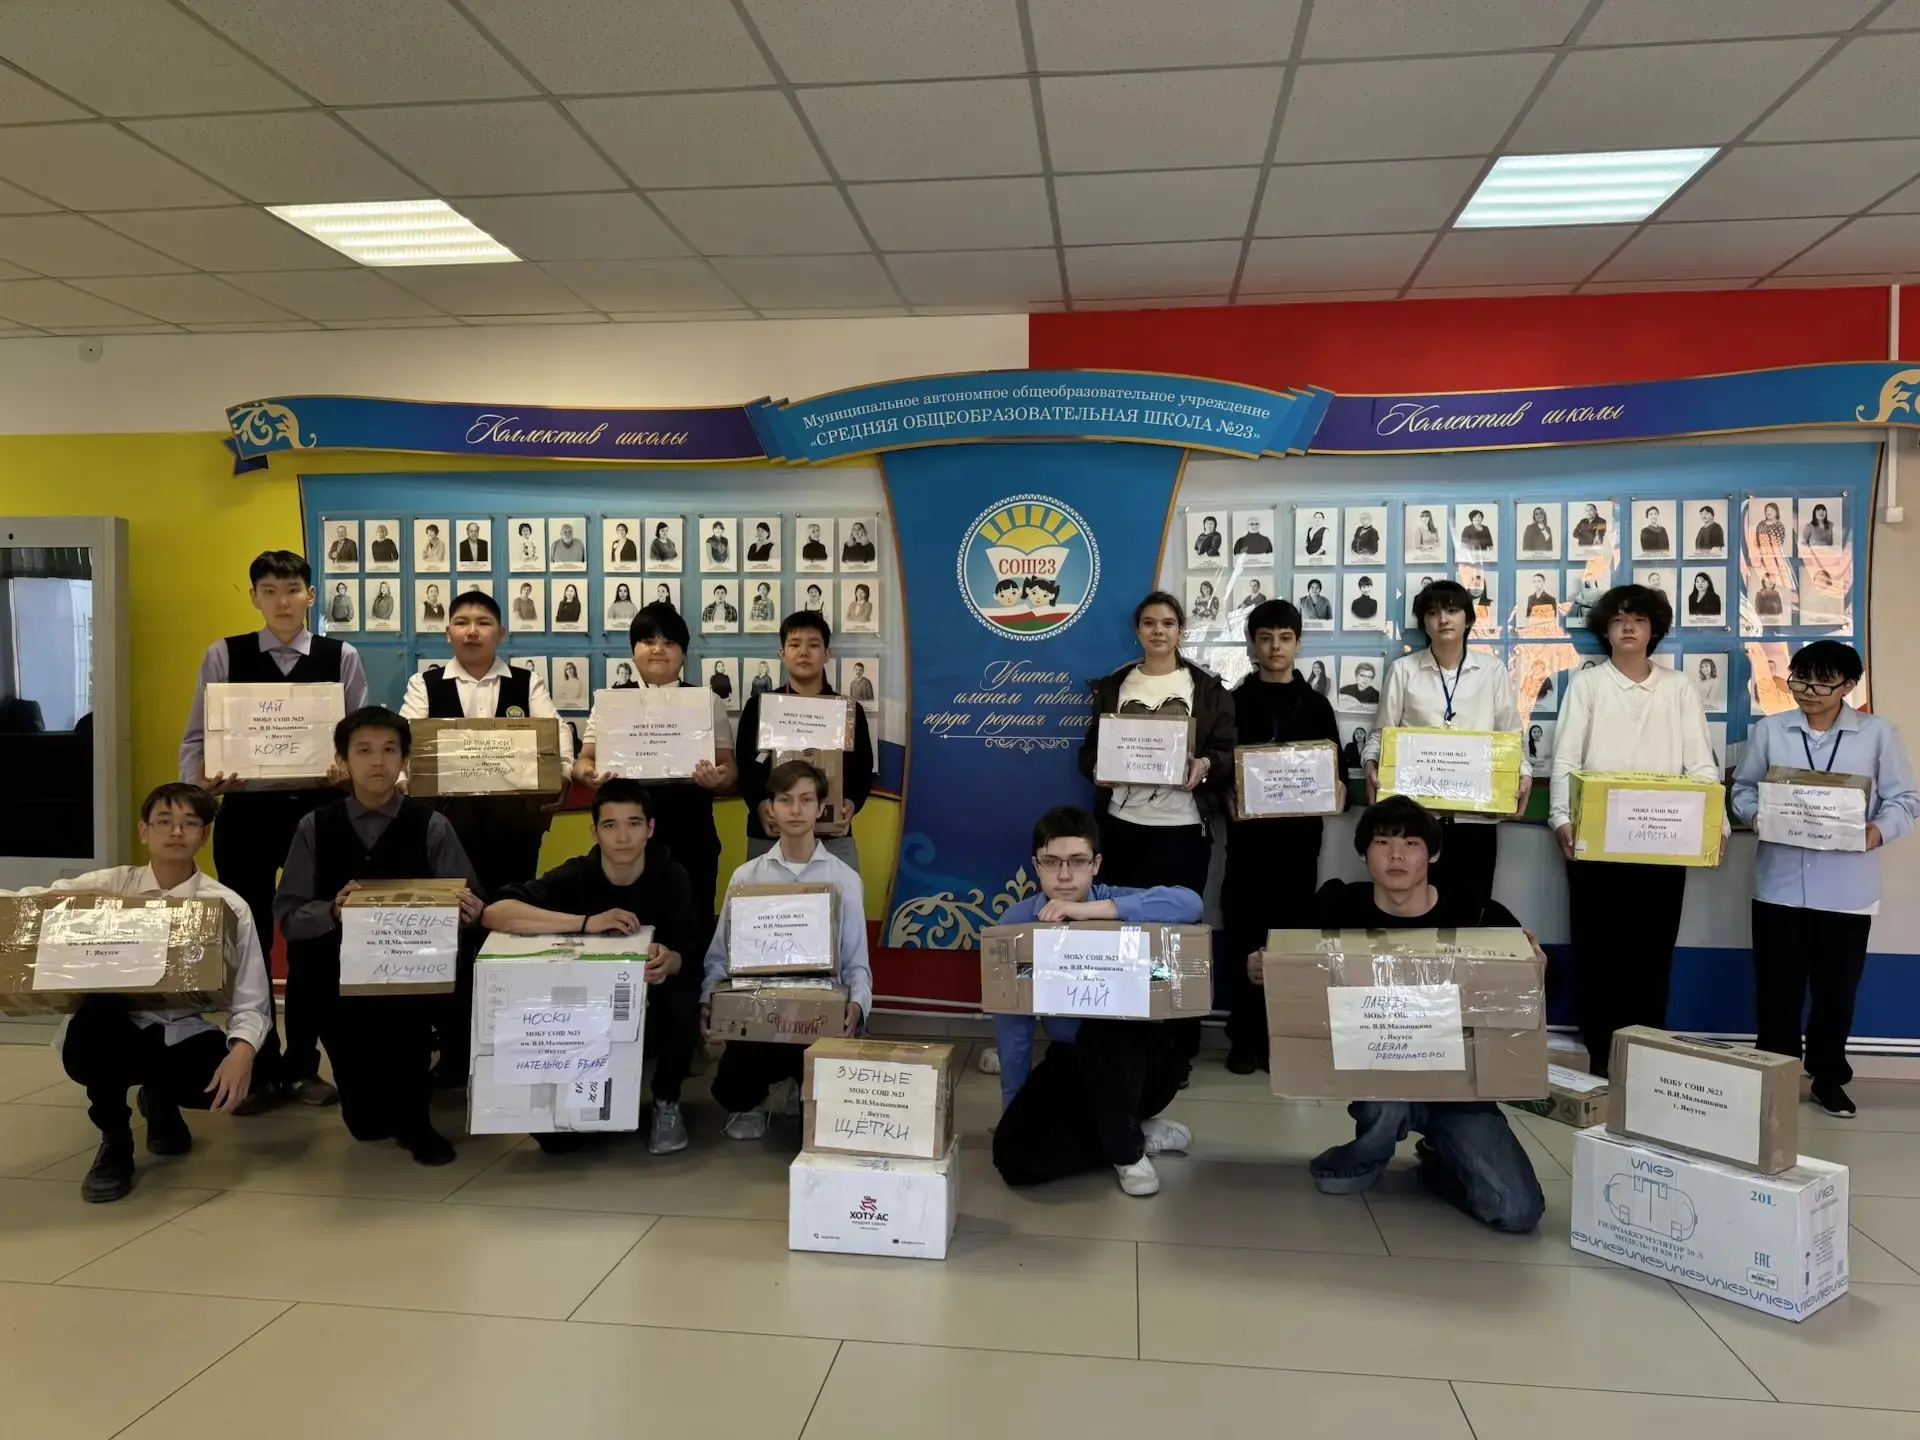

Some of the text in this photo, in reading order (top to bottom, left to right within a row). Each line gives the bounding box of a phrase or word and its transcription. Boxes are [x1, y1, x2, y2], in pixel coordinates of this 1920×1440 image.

[802, 384, 1271, 430] Муниципальное автономное общеобразовательное учреждение
[810, 406, 1260, 447] «СРЕДНЯЯ ОБЩЕОБРАЗОВАТЕЛЬНАЯ ШКОЛА №23»
[1376, 402, 1625, 436] Коллектив школы
[466, 414, 690, 446] Коллектив школы
[998, 558, 1056, 576] СОШ23
[980, 660, 1073, 691] Учитель,
[260, 700, 286, 712] ЧАЙ
[952, 692, 1022, 704] именем
[922, 710, 1094, 735] горда родная шко
[254, 742, 300, 755] КОФЕ
[372, 912, 458, 928] ПЕЧЕНЬЕ
[1067, 982, 1110, 1008] ЧАЙ
[522, 1012, 572, 1026] НОСКИ
[1368, 1042, 1408, 1051] ОДЕЯЛА
[1376, 1051, 1447, 1060] РЕСПИРАТОРЫ
[516, 1060, 570, 1070] НАТЕЛЬНОЕ
[836, 1066, 912, 1085] ЗУБНЫЕ
[849, 1087, 871, 1095] МОБУ
[871, 1089, 890, 1097] СОШ
[1659, 1076, 1723, 1096] МОБУ СОШ №23
[1666, 1089, 1728, 1110] В.И.Малышкина
[867, 1111, 890, 1119] Якутск
[1680, 1104, 1707, 1116] Якутск
[834, 1116, 910, 1141] ЩЁТКИ
[1750, 1190, 1777, 1207] 20L
[1598, 1219, 1685, 1252] ГИДРОАККУМУЛЯТОР
